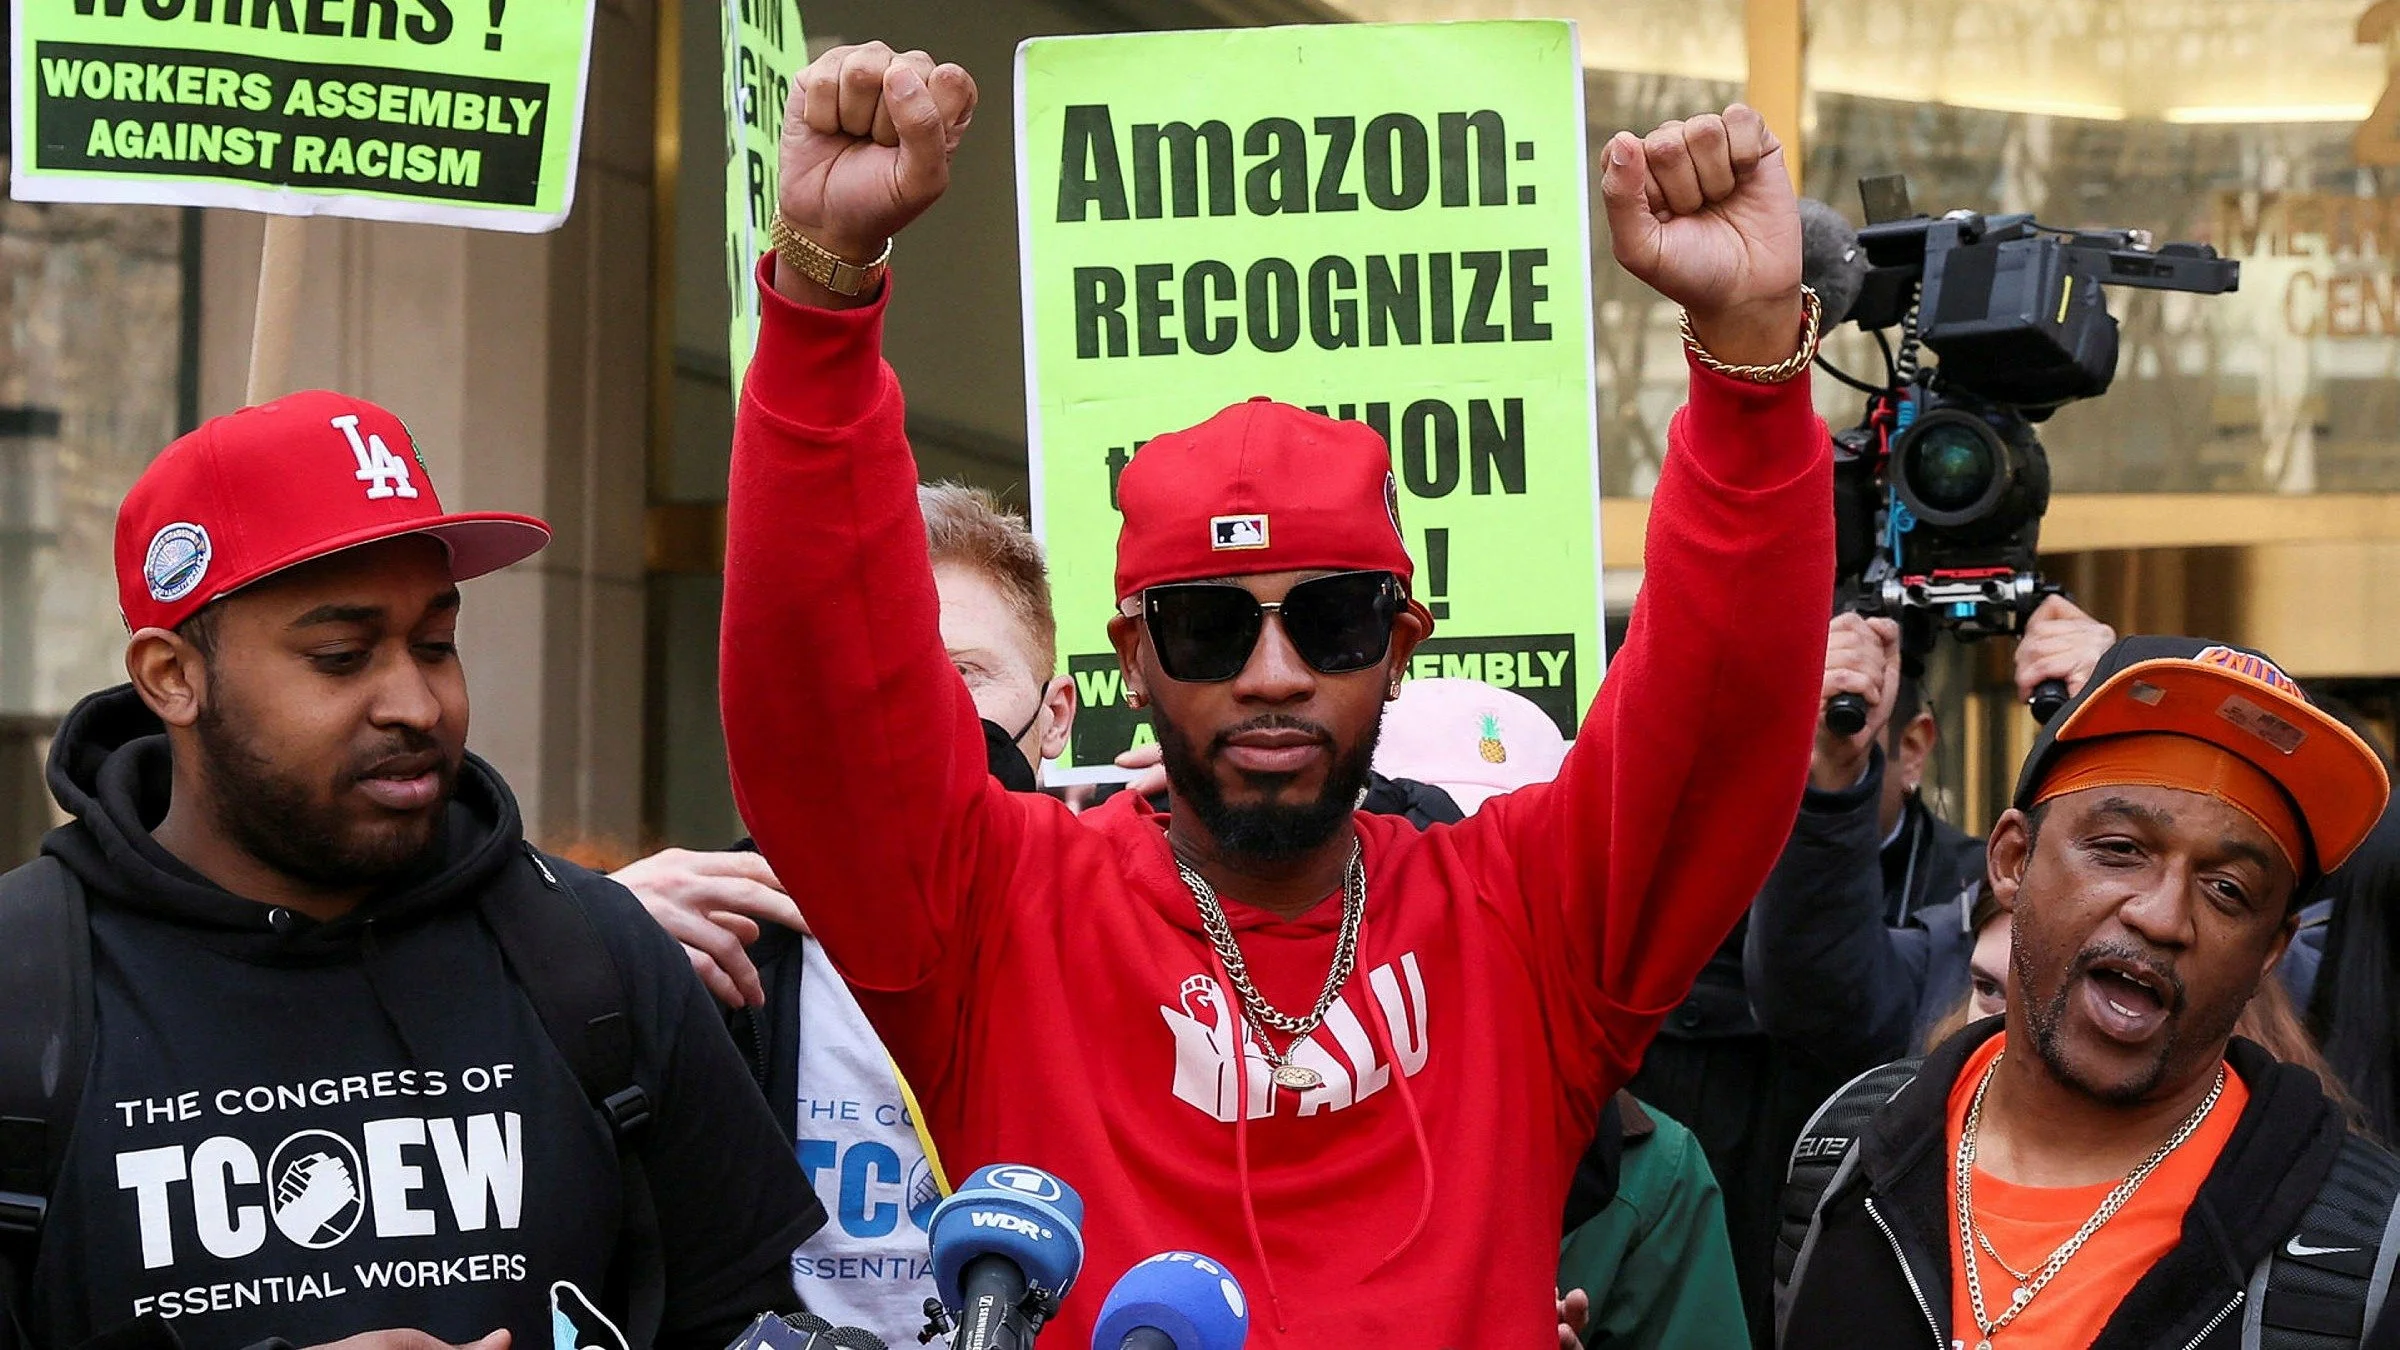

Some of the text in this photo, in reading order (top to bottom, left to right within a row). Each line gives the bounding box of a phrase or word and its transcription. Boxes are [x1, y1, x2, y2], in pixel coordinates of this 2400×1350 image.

[41, 59, 541, 135] WORKERS ASSEMBLY
[86, 119, 481, 187] AGAINST RACISM
[1056, 104, 1536, 223] Amazon:
[1073, 248, 1553, 359] RECOGNIZE
[331, 415, 418, 499] LA
[116, 1064, 514, 1127] THE CONGRESS OF
[798, 1099, 860, 1121] HE
[134, 1254, 527, 1319] ESSENTIAL WORKERS
